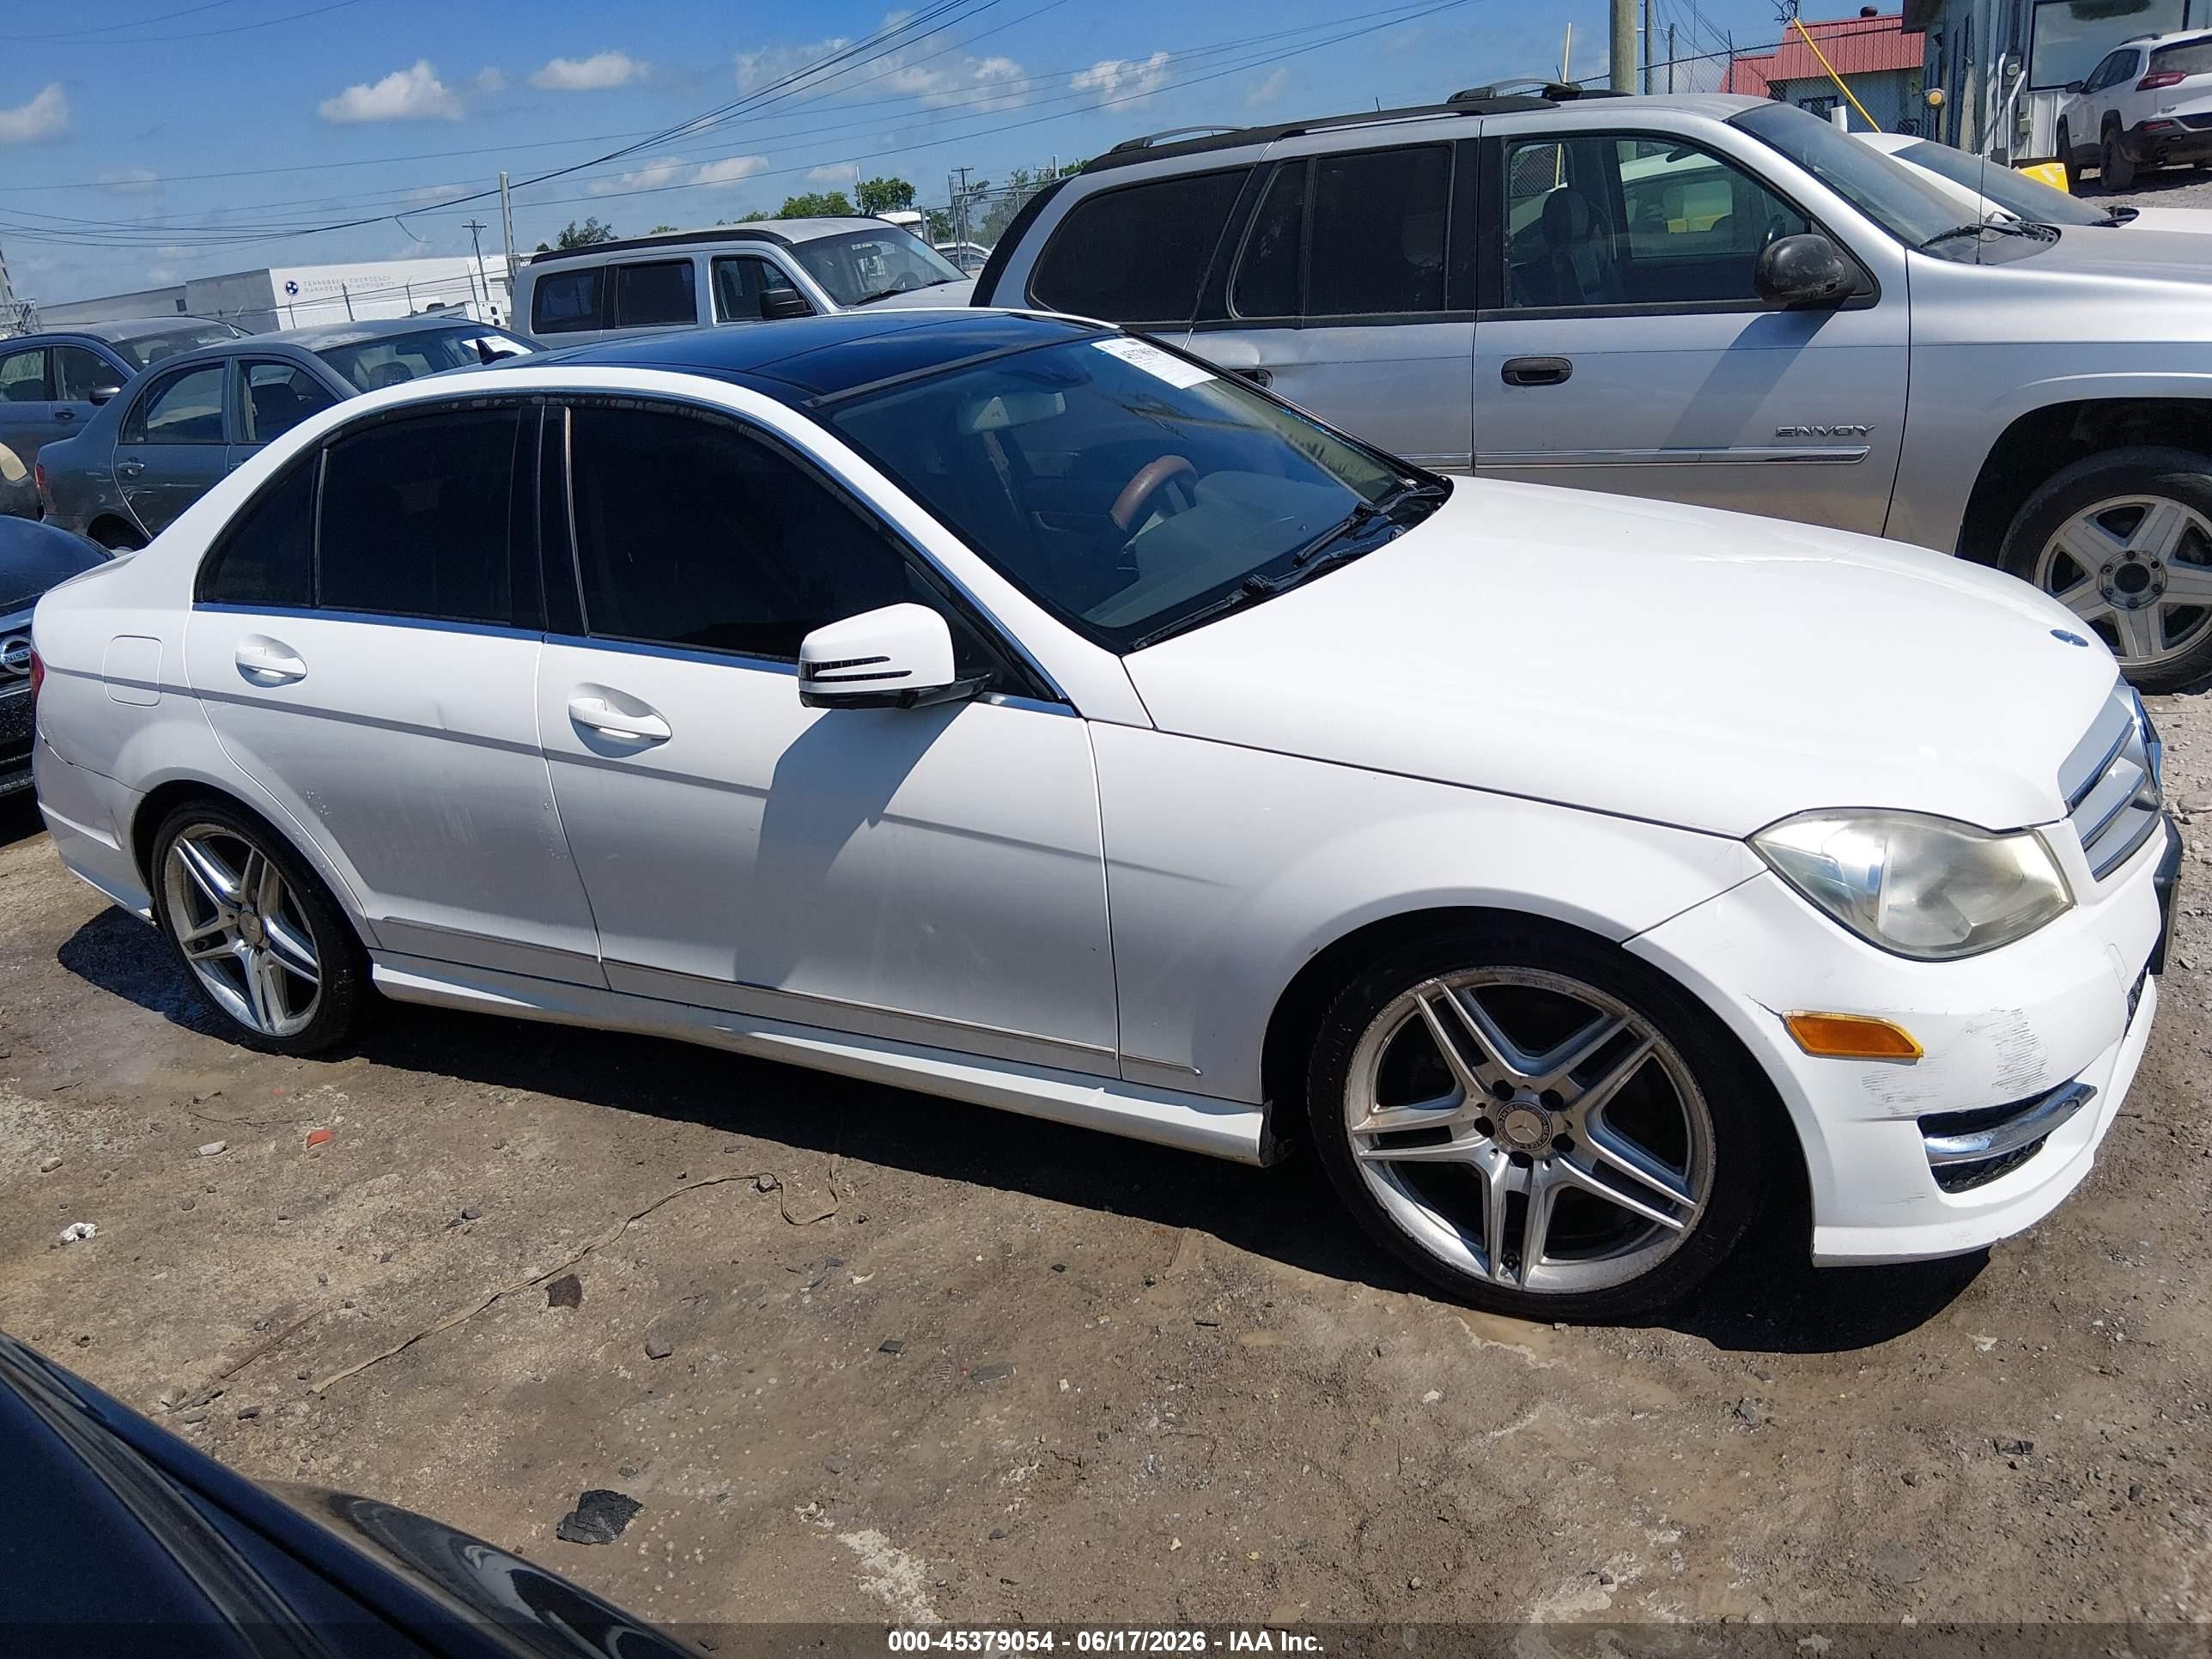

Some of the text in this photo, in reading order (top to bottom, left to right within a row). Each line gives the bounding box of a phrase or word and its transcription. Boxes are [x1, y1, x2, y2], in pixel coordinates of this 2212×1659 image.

[303, 278, 344, 287] TENNESSEE
[1776, 424, 1876, 437] ENVOY
[4, 651, 29, 662] NISS
